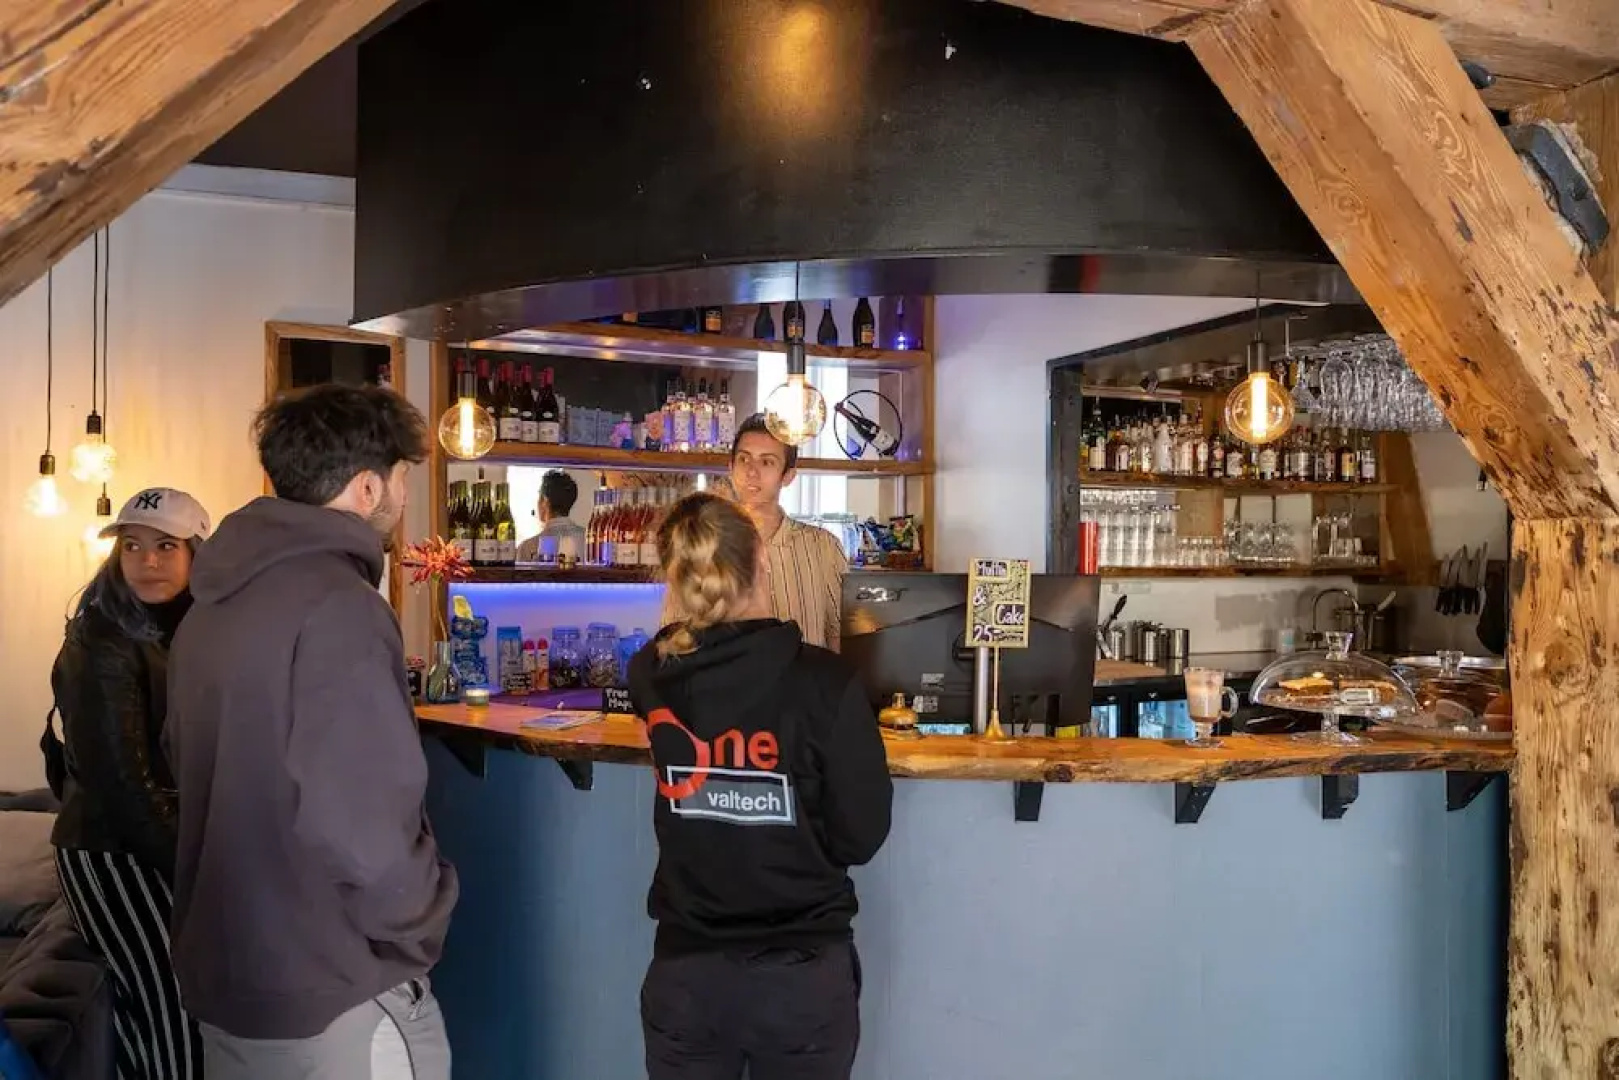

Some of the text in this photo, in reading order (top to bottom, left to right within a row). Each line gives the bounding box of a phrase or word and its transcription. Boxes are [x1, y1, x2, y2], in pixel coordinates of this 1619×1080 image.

[134, 491, 163, 510] NY
[647, 707, 780, 800] One
[707, 790, 781, 812] valtech
